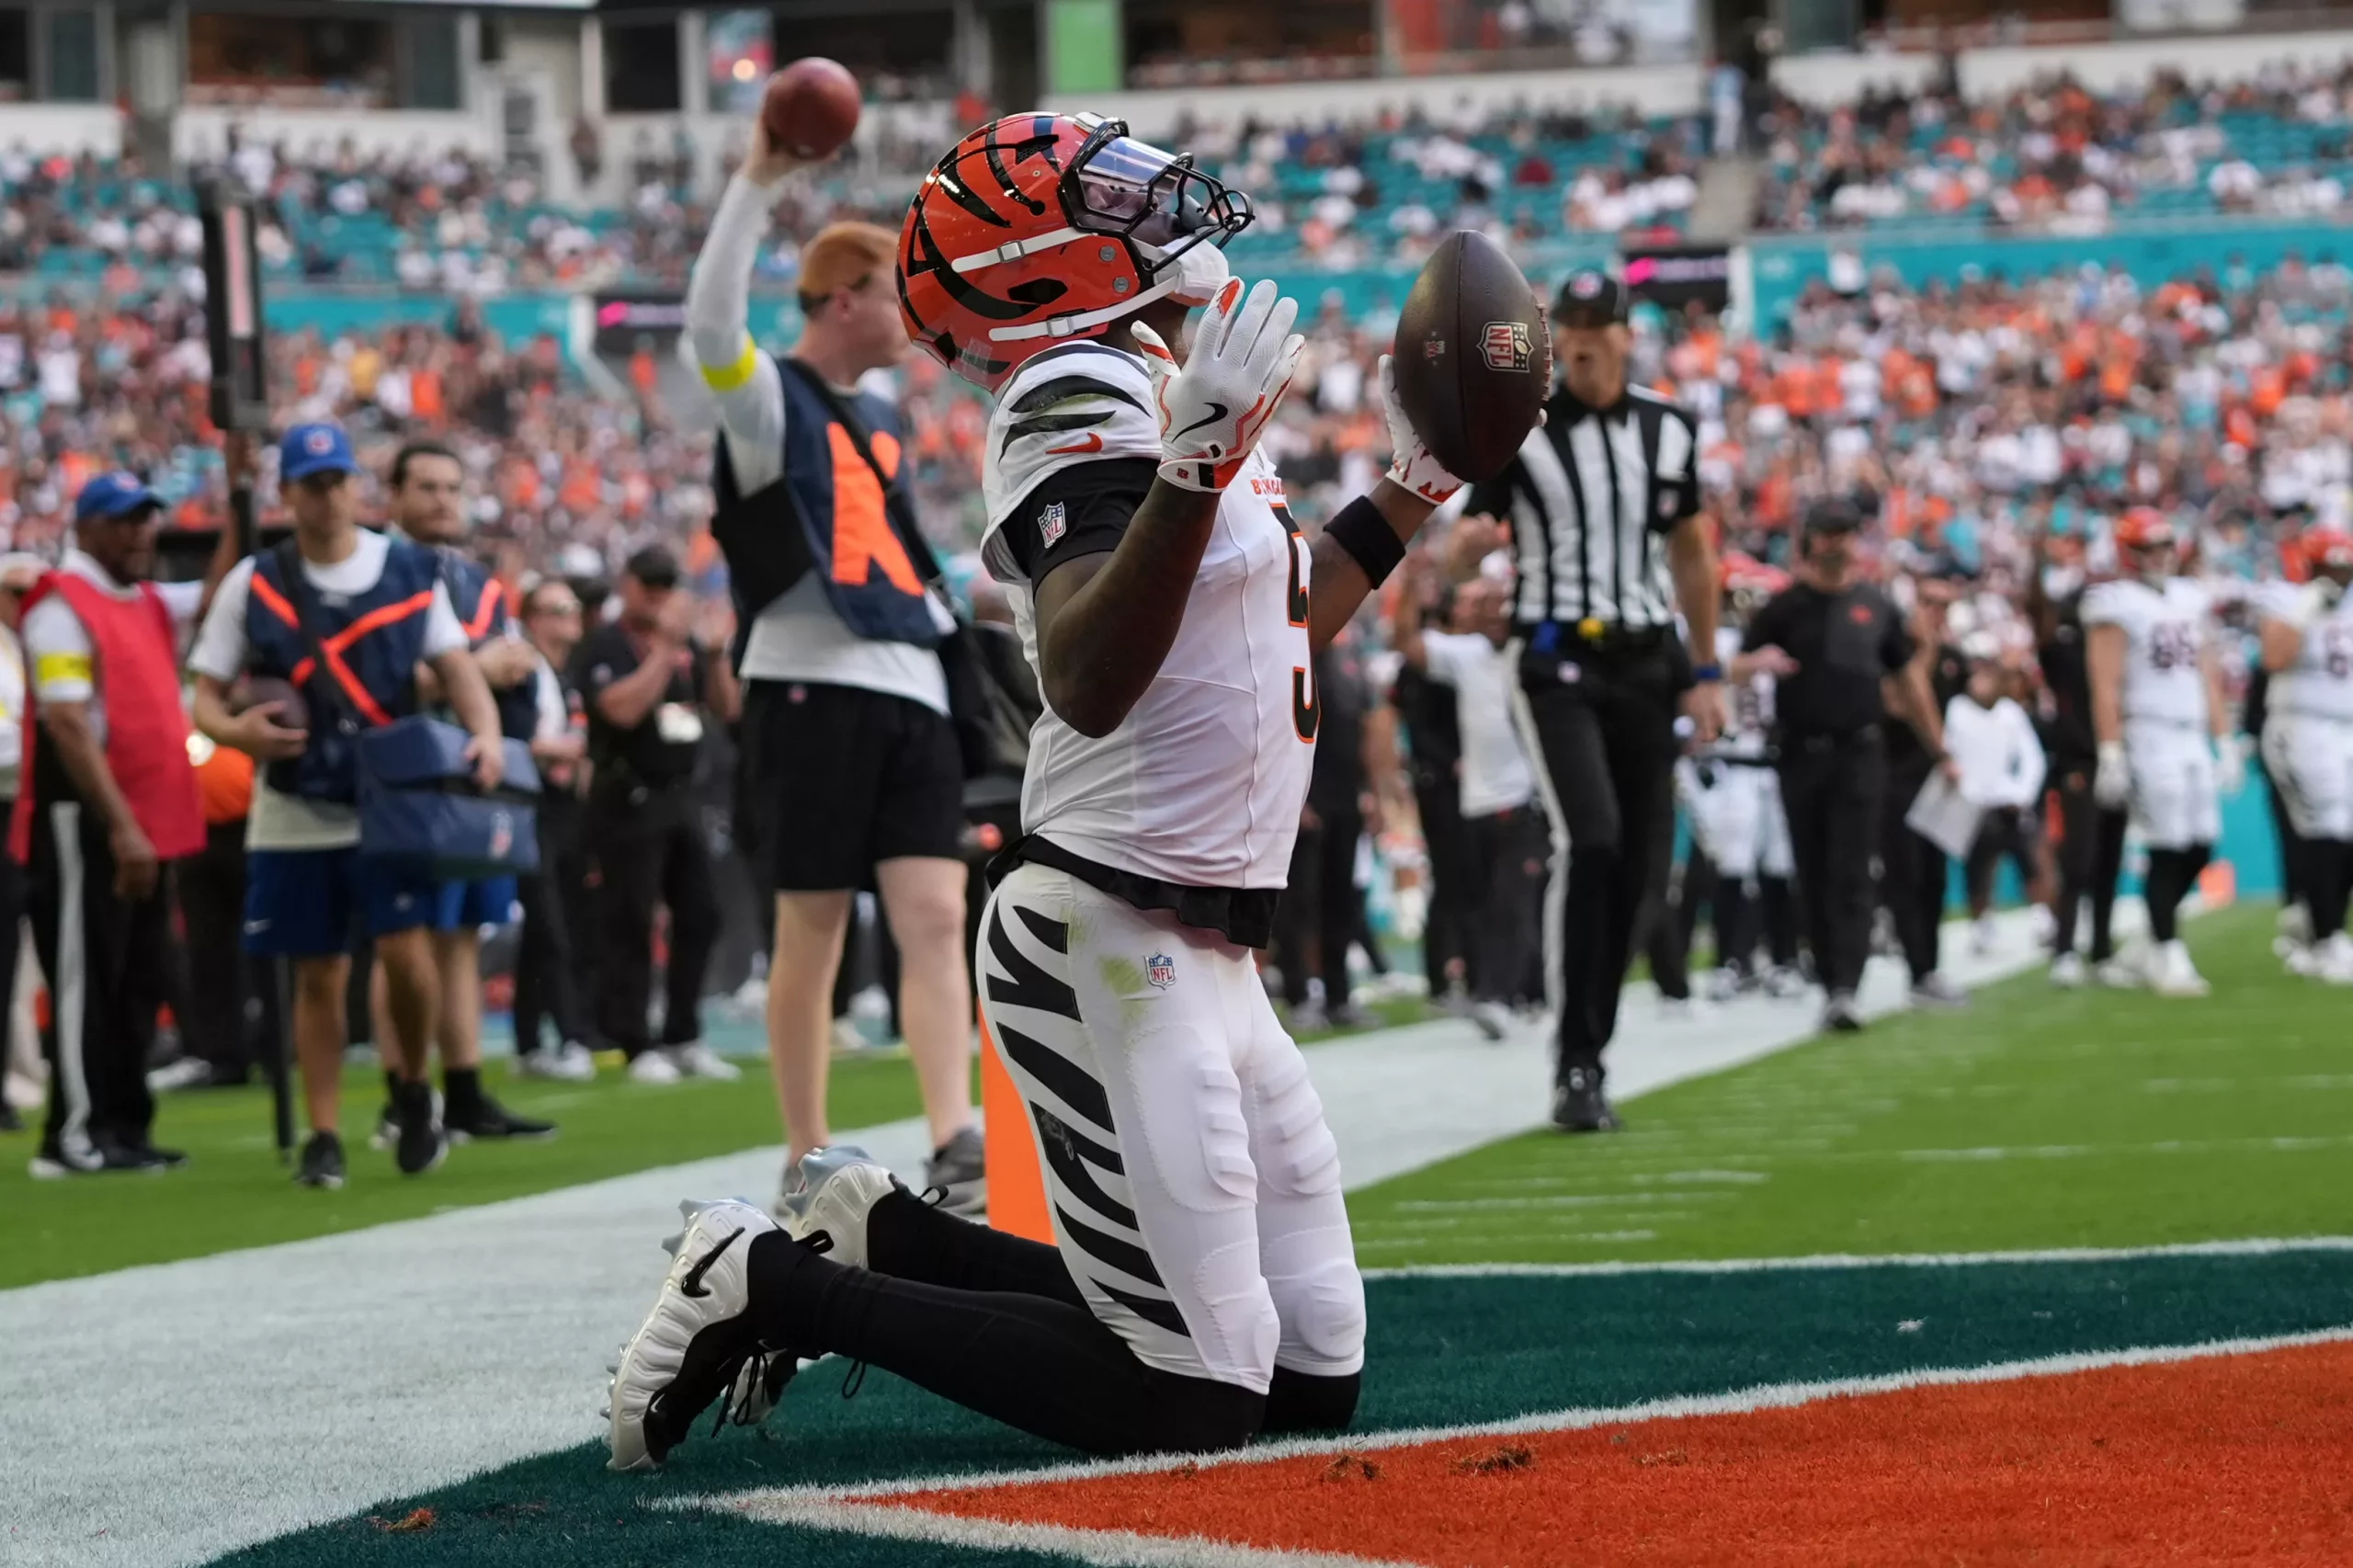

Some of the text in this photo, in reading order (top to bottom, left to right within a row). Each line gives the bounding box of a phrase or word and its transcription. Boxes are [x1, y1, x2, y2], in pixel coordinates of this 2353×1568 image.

[1488, 327, 1512, 365] NFL
[1269, 502, 1321, 744] 5
[1153, 967, 1172, 982] NFL
